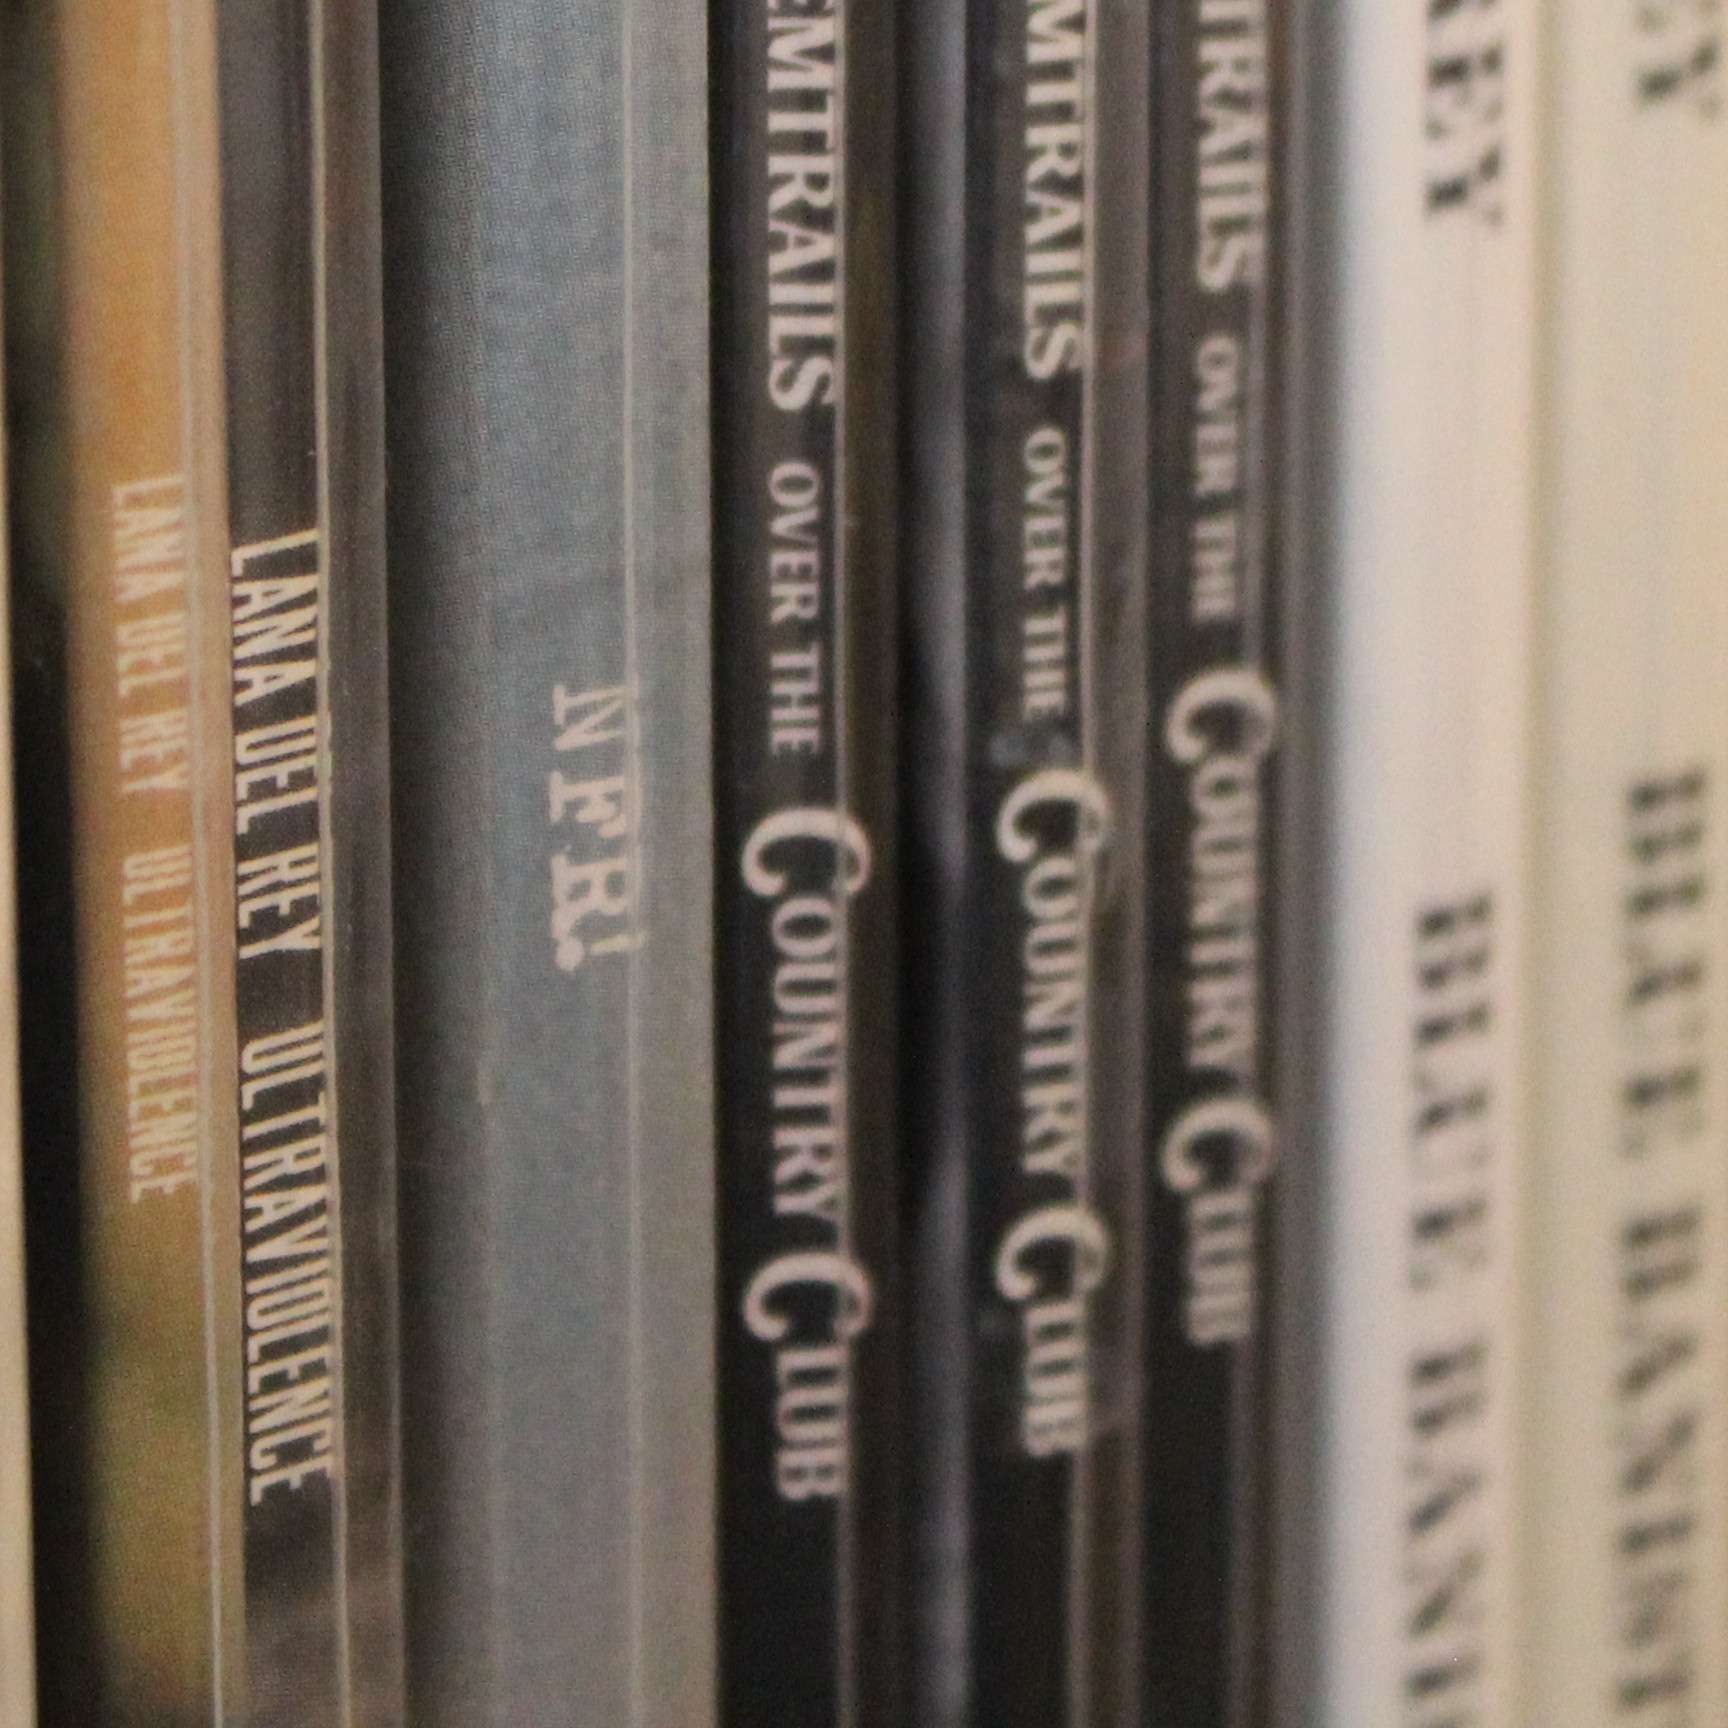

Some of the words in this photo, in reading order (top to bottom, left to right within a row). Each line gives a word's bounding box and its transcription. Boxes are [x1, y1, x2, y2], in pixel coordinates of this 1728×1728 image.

[1192, 334, 1242, 498] OVER
[113, 474, 191, 604] LANA
[768, 462, 822, 623] OVER
[1020, 427, 1070, 590] OVER
[116, 608, 194, 698] DEL
[230, 527, 324, 706] LANA
[1020, 602, 1070, 725] THE
[119, 706, 199, 796] REY
[234, 712, 332, 836] DEL
[768, 640, 822, 758] THE
[236, 840, 330, 961] REY
[995, 772, 1112, 1176] COUNTRY
[1620, 766, 1710, 1165] BLUE
[120, 844, 206, 1204] ULTRAVIOLENCE
[740, 806, 872, 1220] COUNTRY
[1410, 888, 1494, 1296] BLUE
[239, 1020, 341, 1508] ULTRAVIOLENCE
[994, 1206, 1111, 1459] CLUB
[742, 1250, 872, 1502] CLUB
